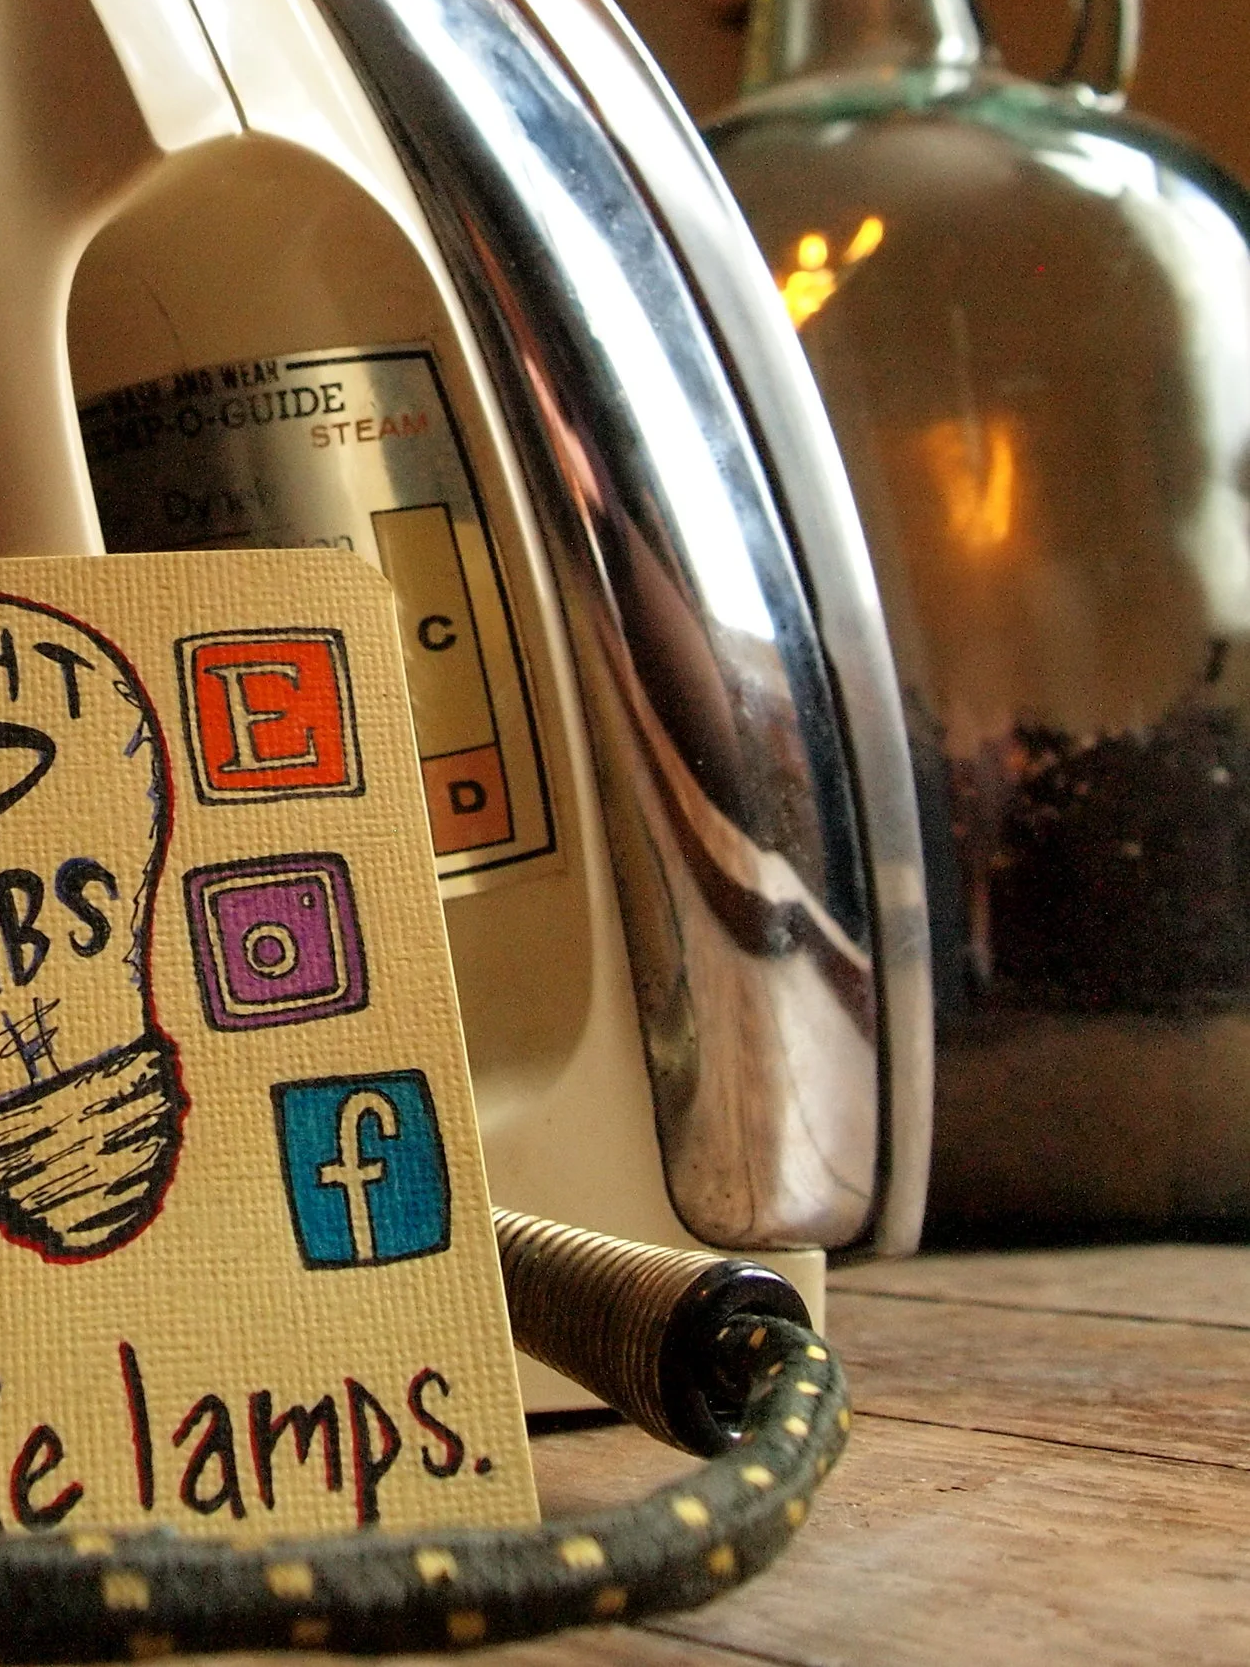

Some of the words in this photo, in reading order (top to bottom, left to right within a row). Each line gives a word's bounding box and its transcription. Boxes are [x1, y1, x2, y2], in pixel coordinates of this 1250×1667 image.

[173, 368, 213, 397] AND
[220, 359, 280, 389] WEAR
[311, 411, 429, 449] STEAM
[417, 615, 457, 652] C
[203, 660, 318, 774] E
[447, 779, 487, 815] D
[318, 1087, 398, 1261] f
[119, 1341, 493, 1528] lamps.
